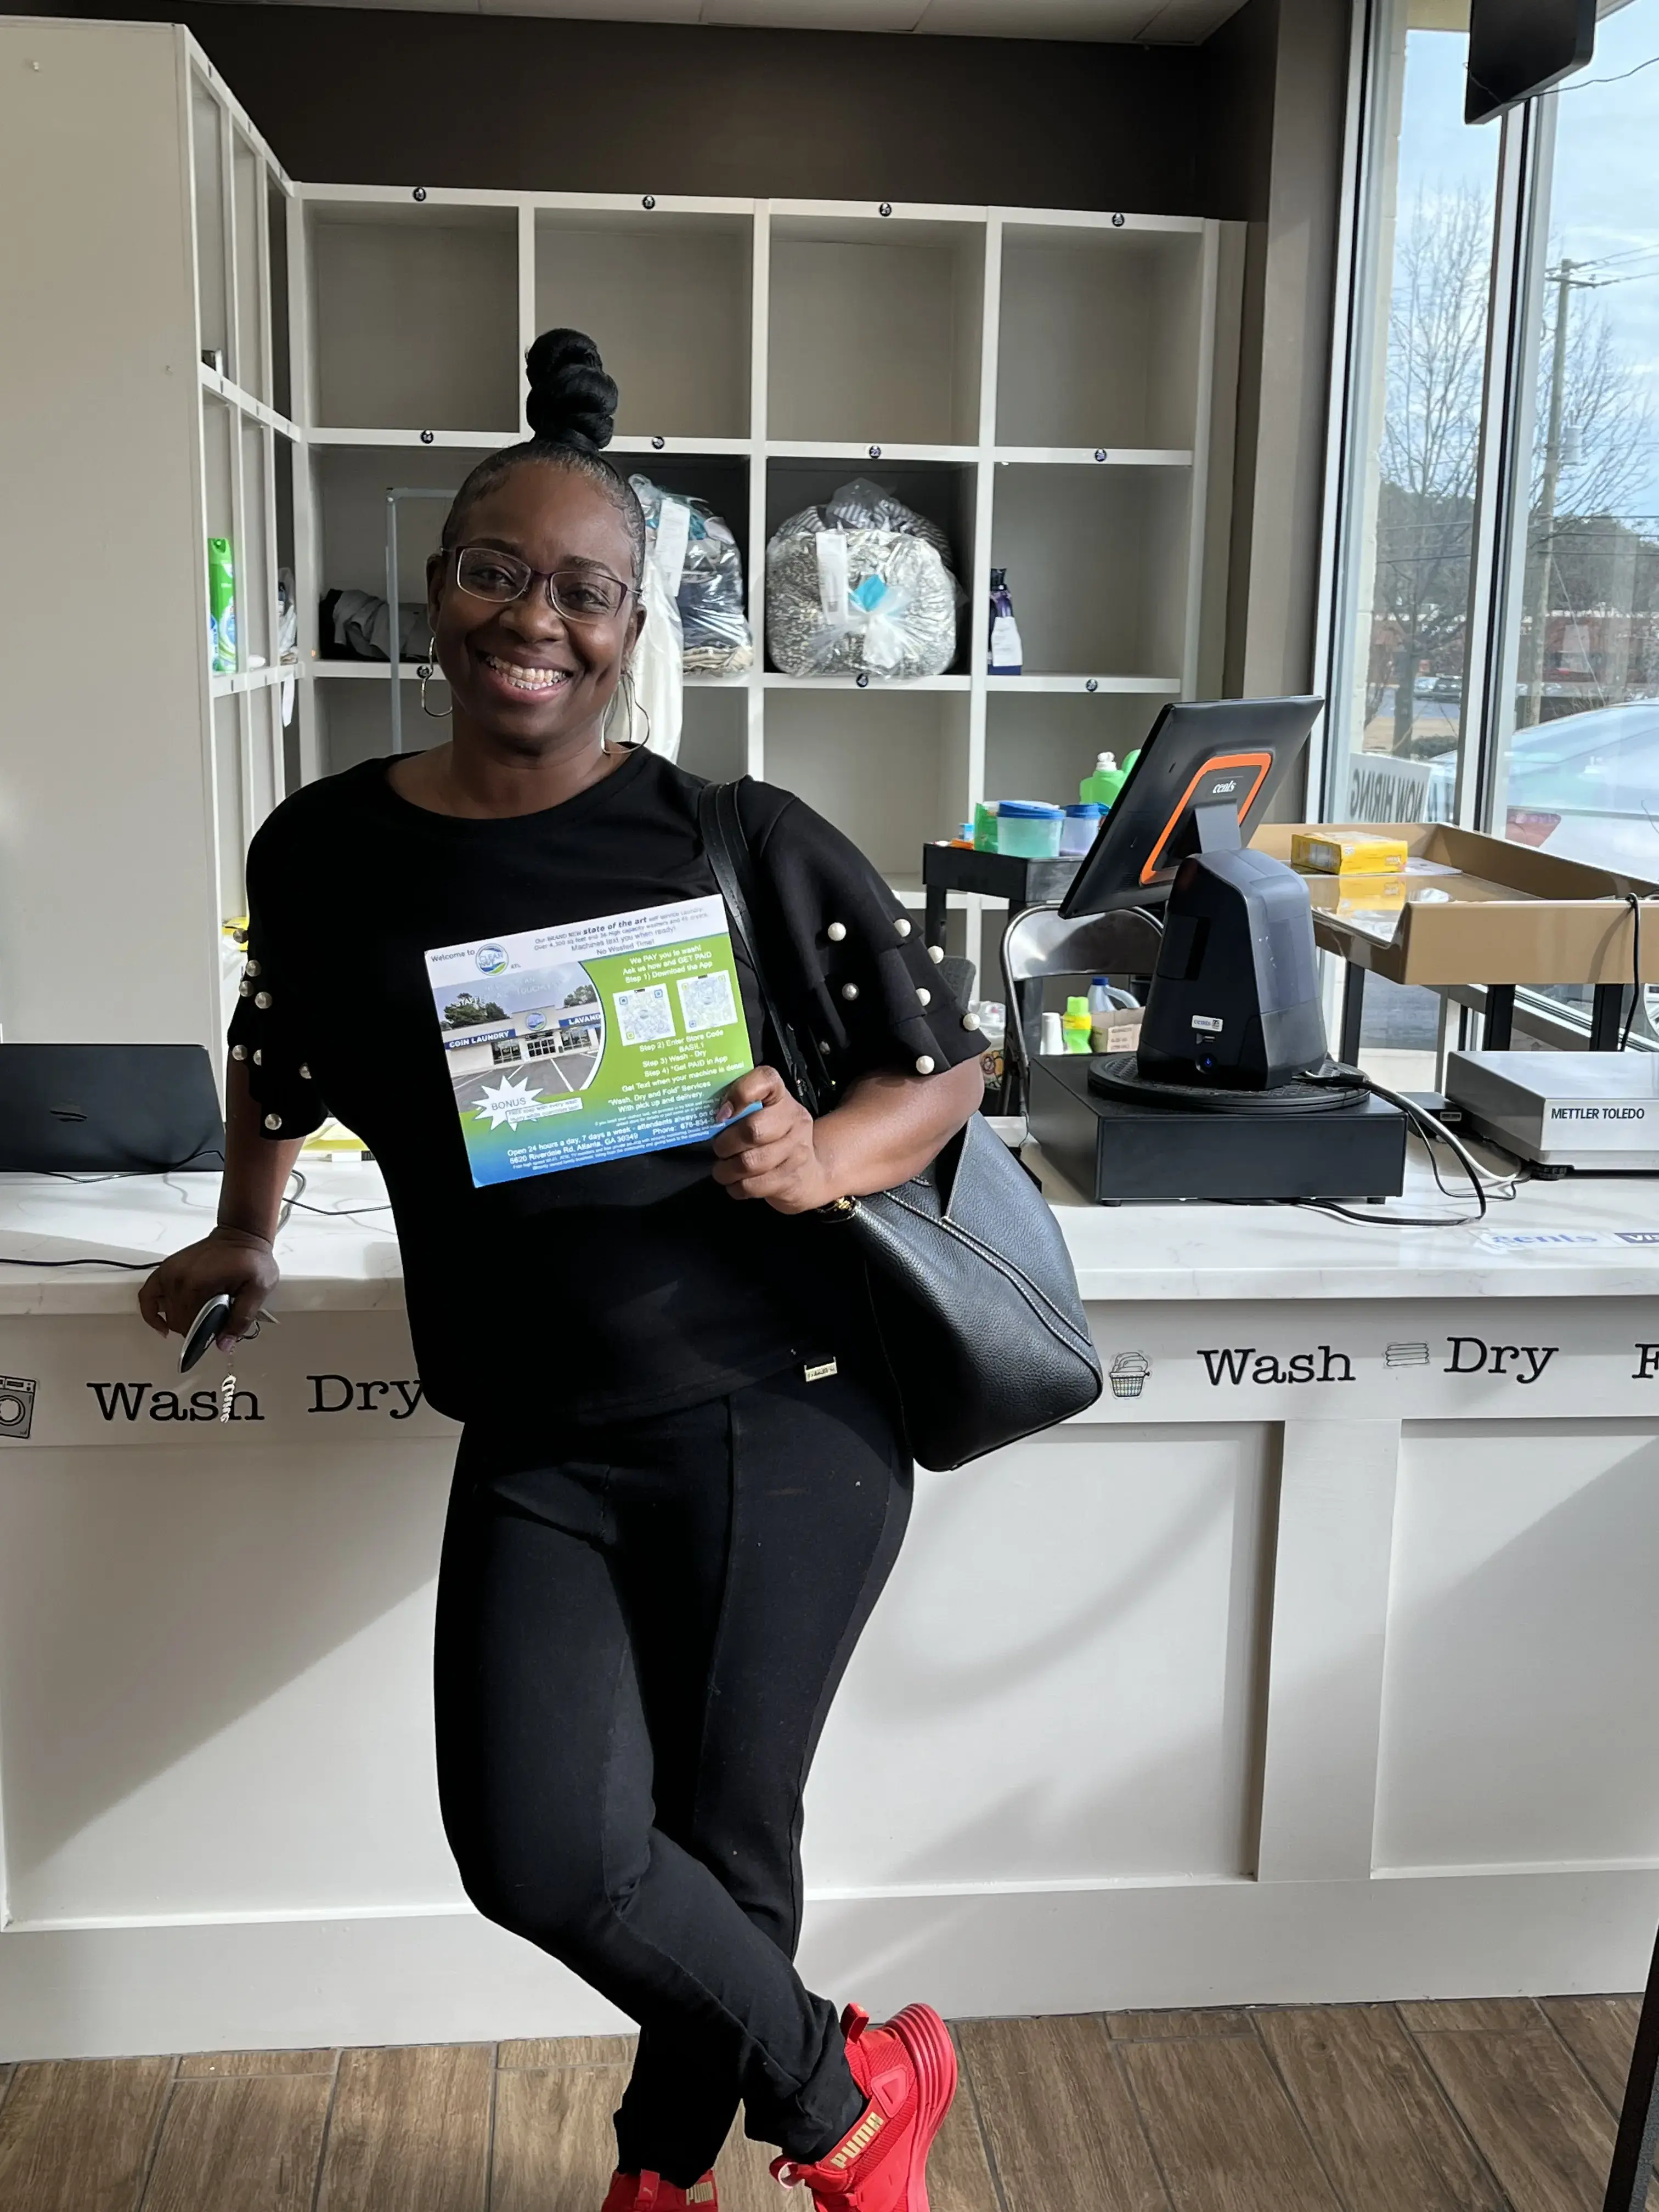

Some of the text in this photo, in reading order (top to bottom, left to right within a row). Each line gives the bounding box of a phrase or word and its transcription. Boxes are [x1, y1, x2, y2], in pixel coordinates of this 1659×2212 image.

[583, 926, 605, 934] state
[571, 941, 604, 951] Machines
[654, 926, 675, 934] ready!
[608, 943, 634, 952] Wasted
[642, 953, 657, 961] PAY
[658, 952, 672, 960] you
[681, 944, 701, 953] wash!
[431, 952, 465, 962] Welcome
[623, 967, 636, 975] Ask
[663, 958, 676, 967] and
[678, 955, 692, 963] GET
[694, 951, 712, 960] PAID
[625, 975, 641, 983] Step
[643, 972, 650, 980] 1)
[651, 966, 685, 978] Download
[449, 1031, 508, 1047] COIN LAUNDRY
[639, 1043, 655, 1052] Step
[665, 1037, 684, 1046] Enter
[706, 1029, 723, 1038] Code
[668, 1053, 688, 1062] Wash
[687, 1059, 705, 1068] PAID
[714, 1055, 727, 1063] App
[652, 1077, 670, 1086] when
[672, 1074, 686, 1084] your
[689, 1068, 717, 1078] machine
[726, 1060, 744, 1071] done!
[681, 1081, 710, 1091] Services
[491, 1097, 526, 1110] BONUS
[635, 1101, 650, 1110] pick
[1551, 1108, 1645, 1120] METTLER TOLEDO
[507, 1148, 527, 1156] Open
[588, 1132, 605, 1140] days
[674, 1114, 697, 1122] always
[652, 1125, 677, 1135] Phone:
[528, 1149, 561, 1159] Riverdale
[1197, 1345, 1356, 1385] Wash
[1443, 1336, 1559, 1385] Dry
[87, 1374, 425, 1422] Wash Dry
[830, 2111, 884, 2169] PUMA
